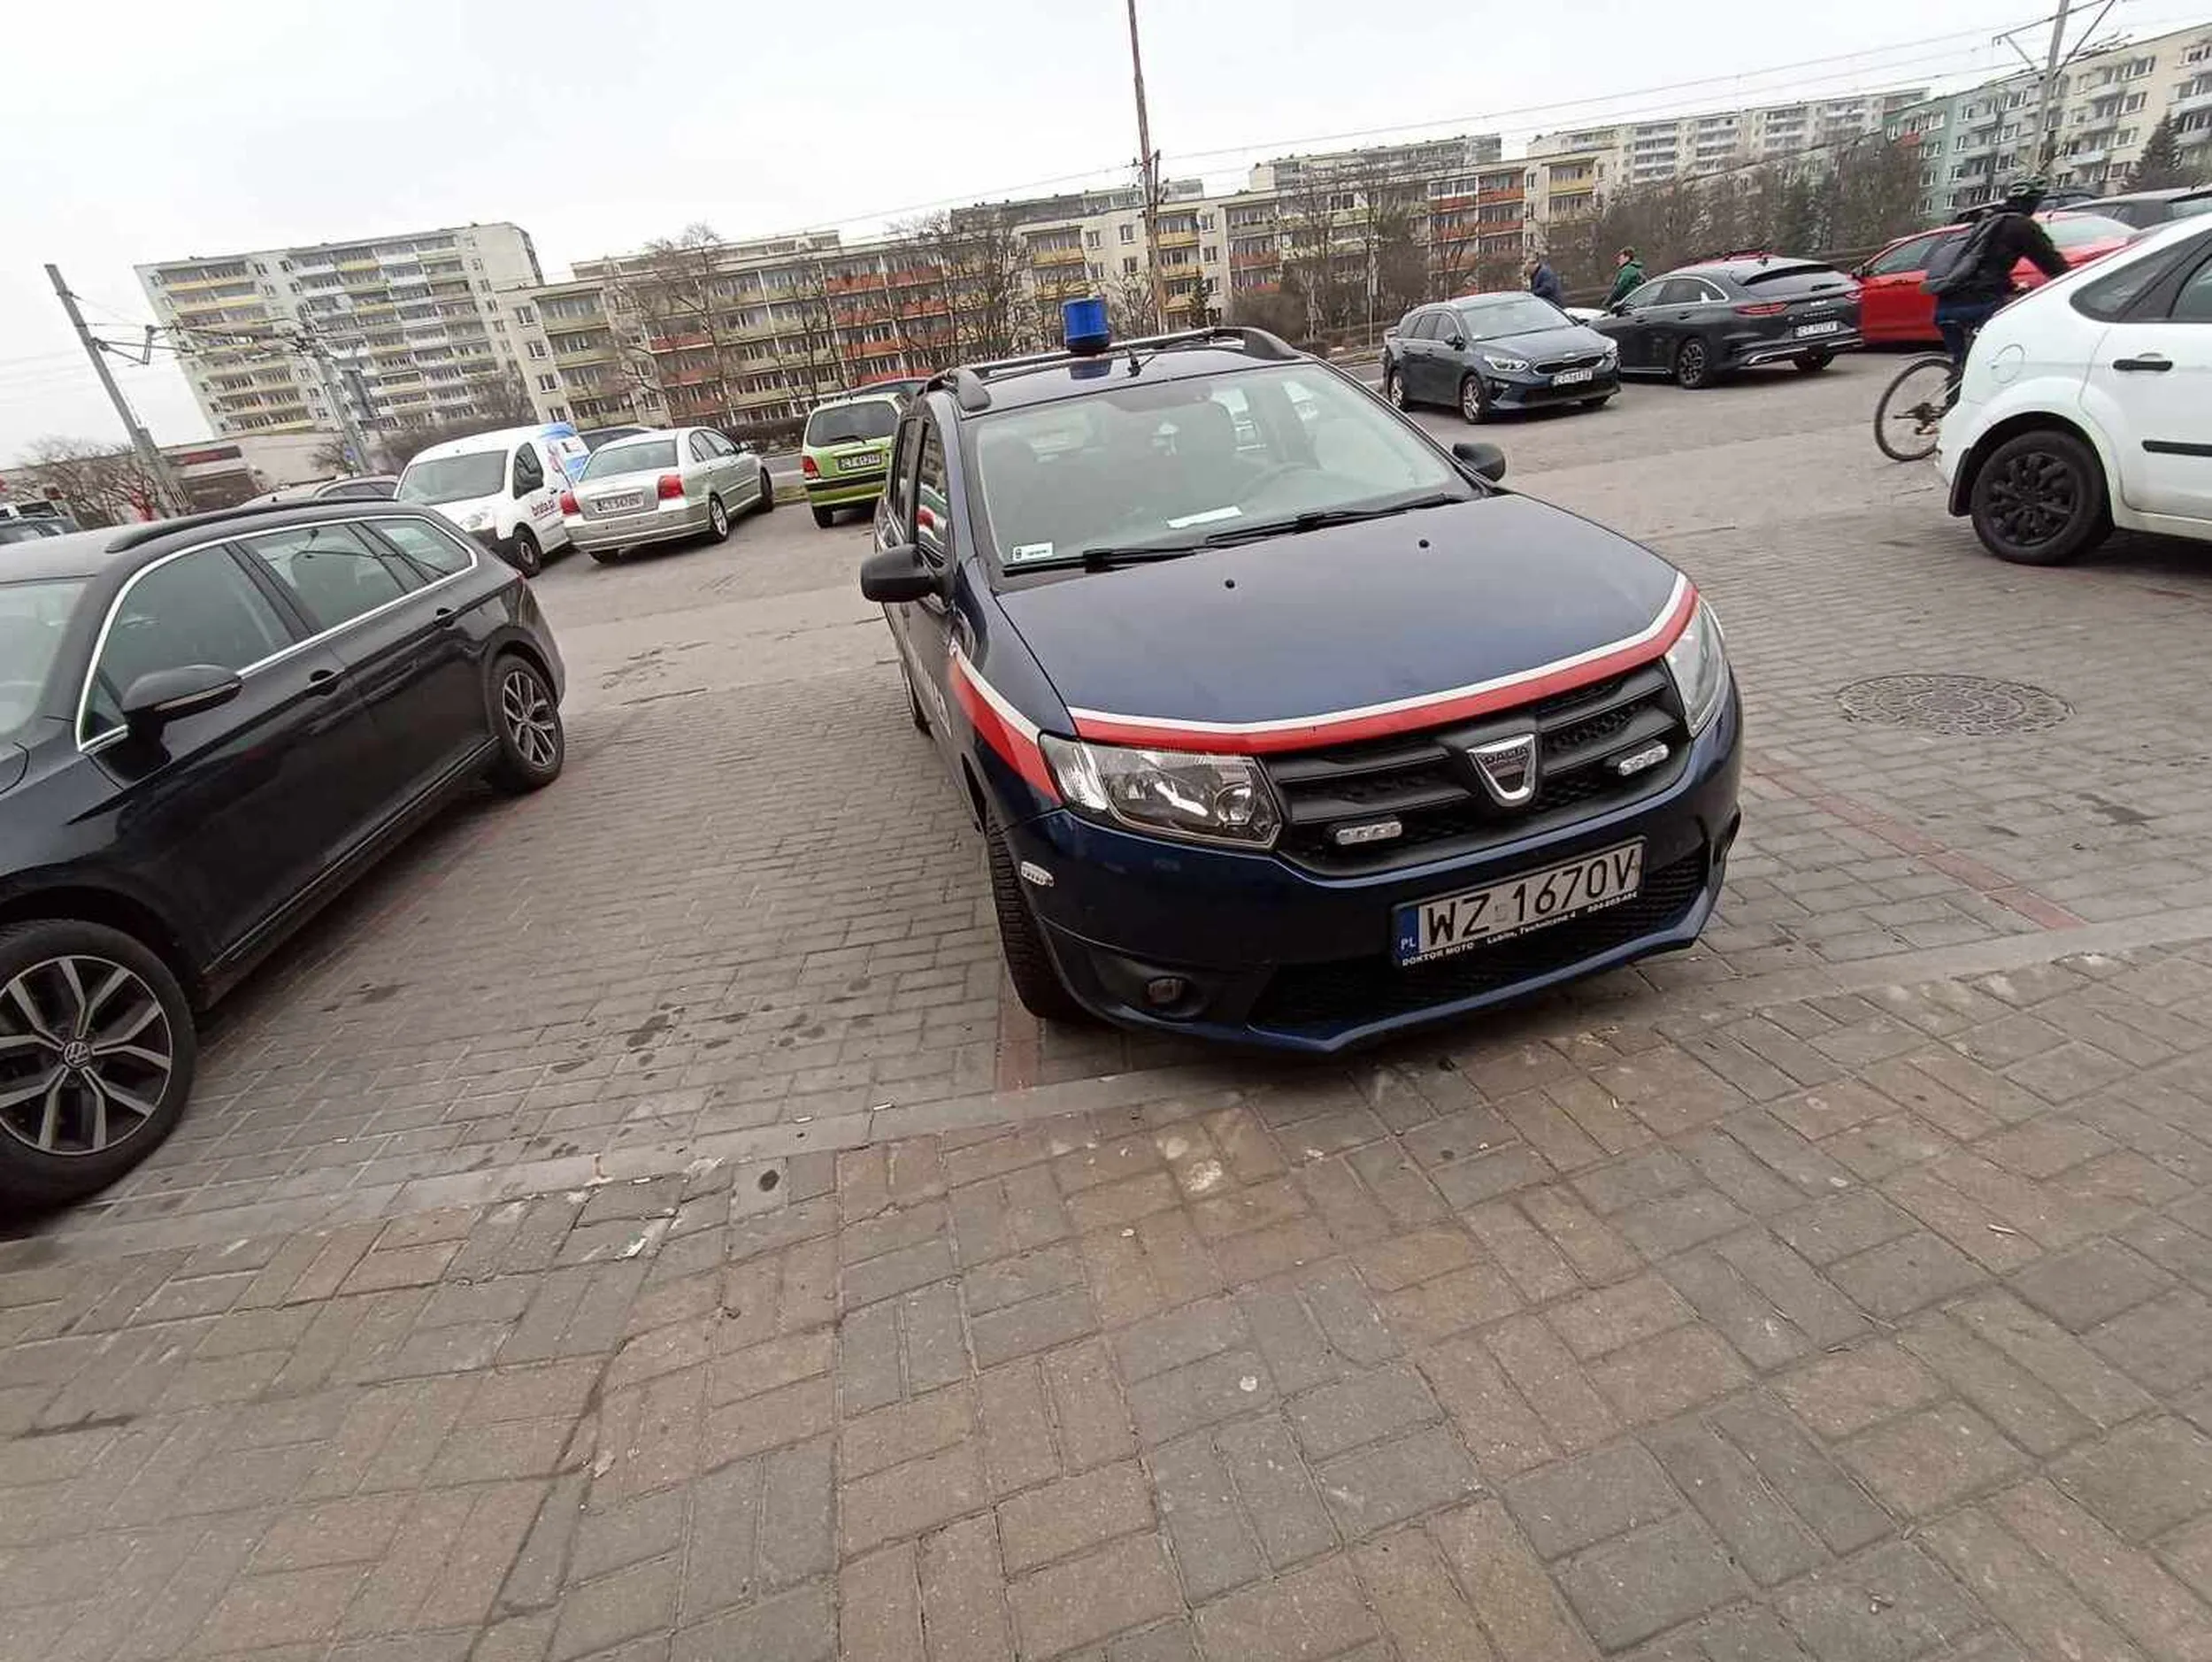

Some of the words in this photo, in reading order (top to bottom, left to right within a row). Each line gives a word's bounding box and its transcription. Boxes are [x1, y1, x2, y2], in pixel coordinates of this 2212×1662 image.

[1427, 893, 1490, 945] WZ
[1512, 849, 1635, 922] 1670V
[1401, 937, 1416, 950] PL
[1402, 951, 1443, 966] DOKTOR
[1446, 942, 1475, 955] MOTO
